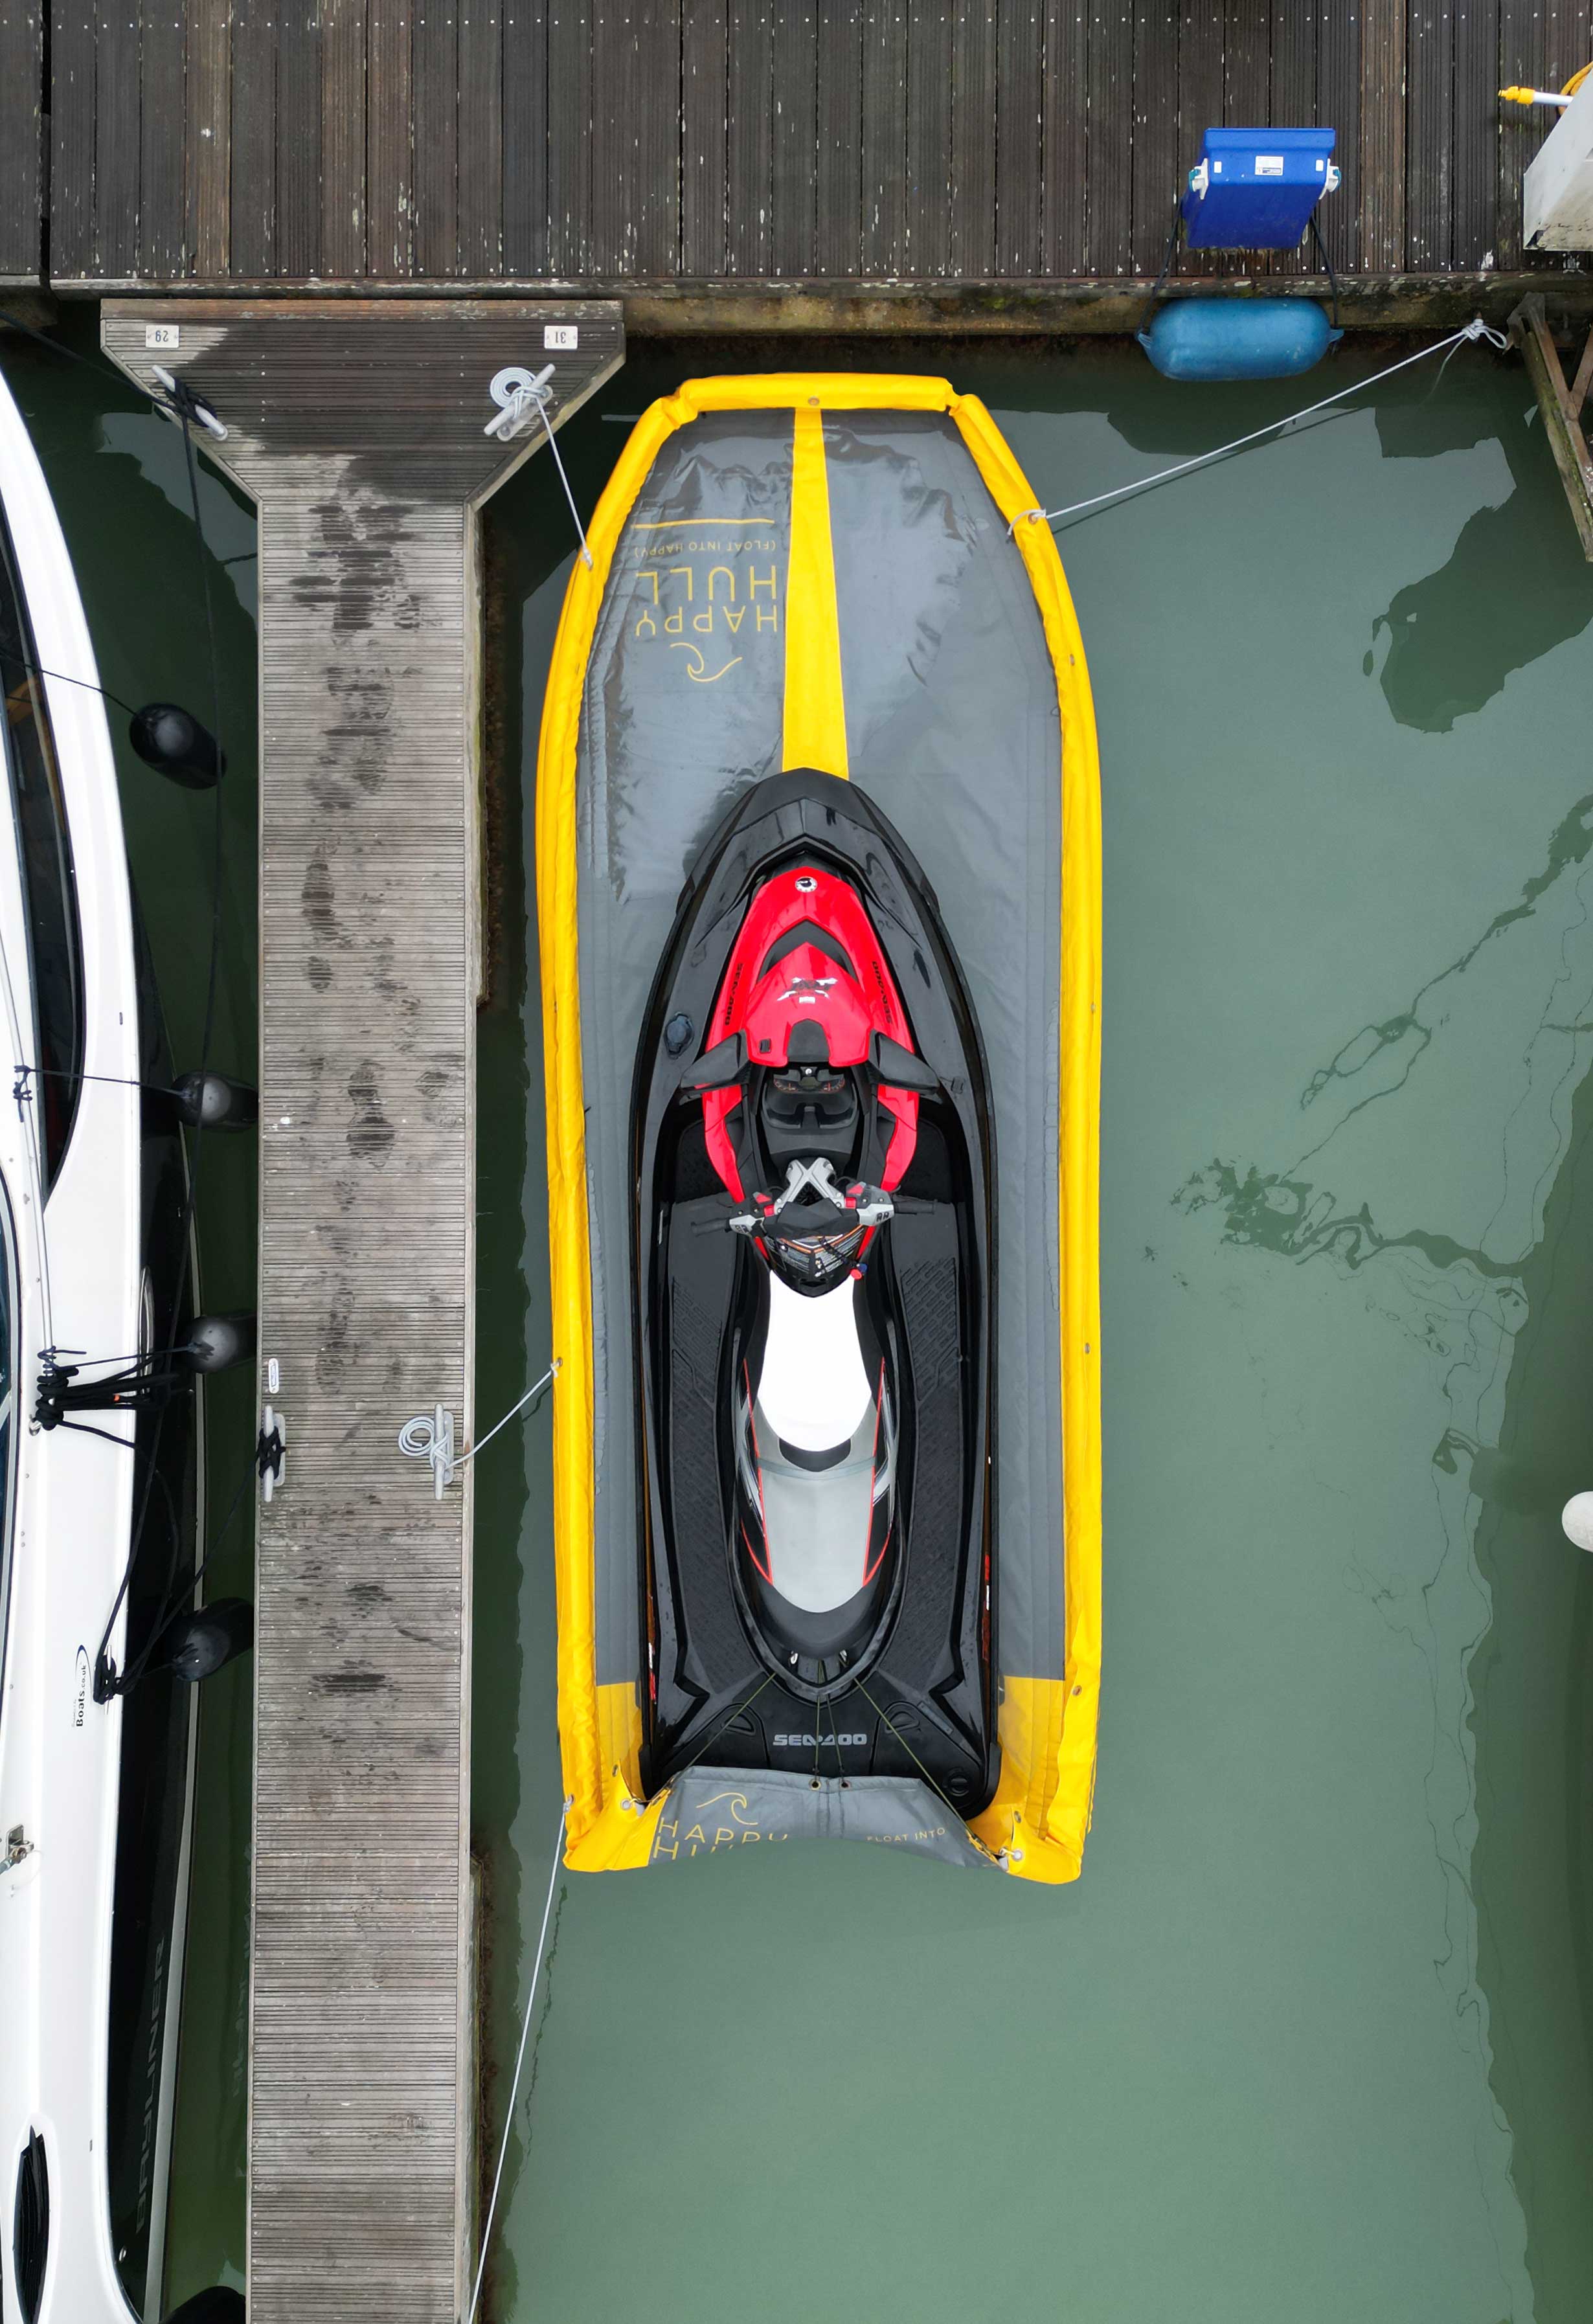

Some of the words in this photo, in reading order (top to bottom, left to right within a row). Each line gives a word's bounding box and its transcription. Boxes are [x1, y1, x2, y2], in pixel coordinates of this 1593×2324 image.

[155, 330, 168, 343] 29
[555, 331, 566, 343] 31
[688, 541, 721, 551] INTO
[635, 565, 777, 605] HULL
[635, 605, 778, 637] HAPPY
[914, 1827, 946, 1840] INTO
[135, 1936, 164, 2234] BAYLINER
